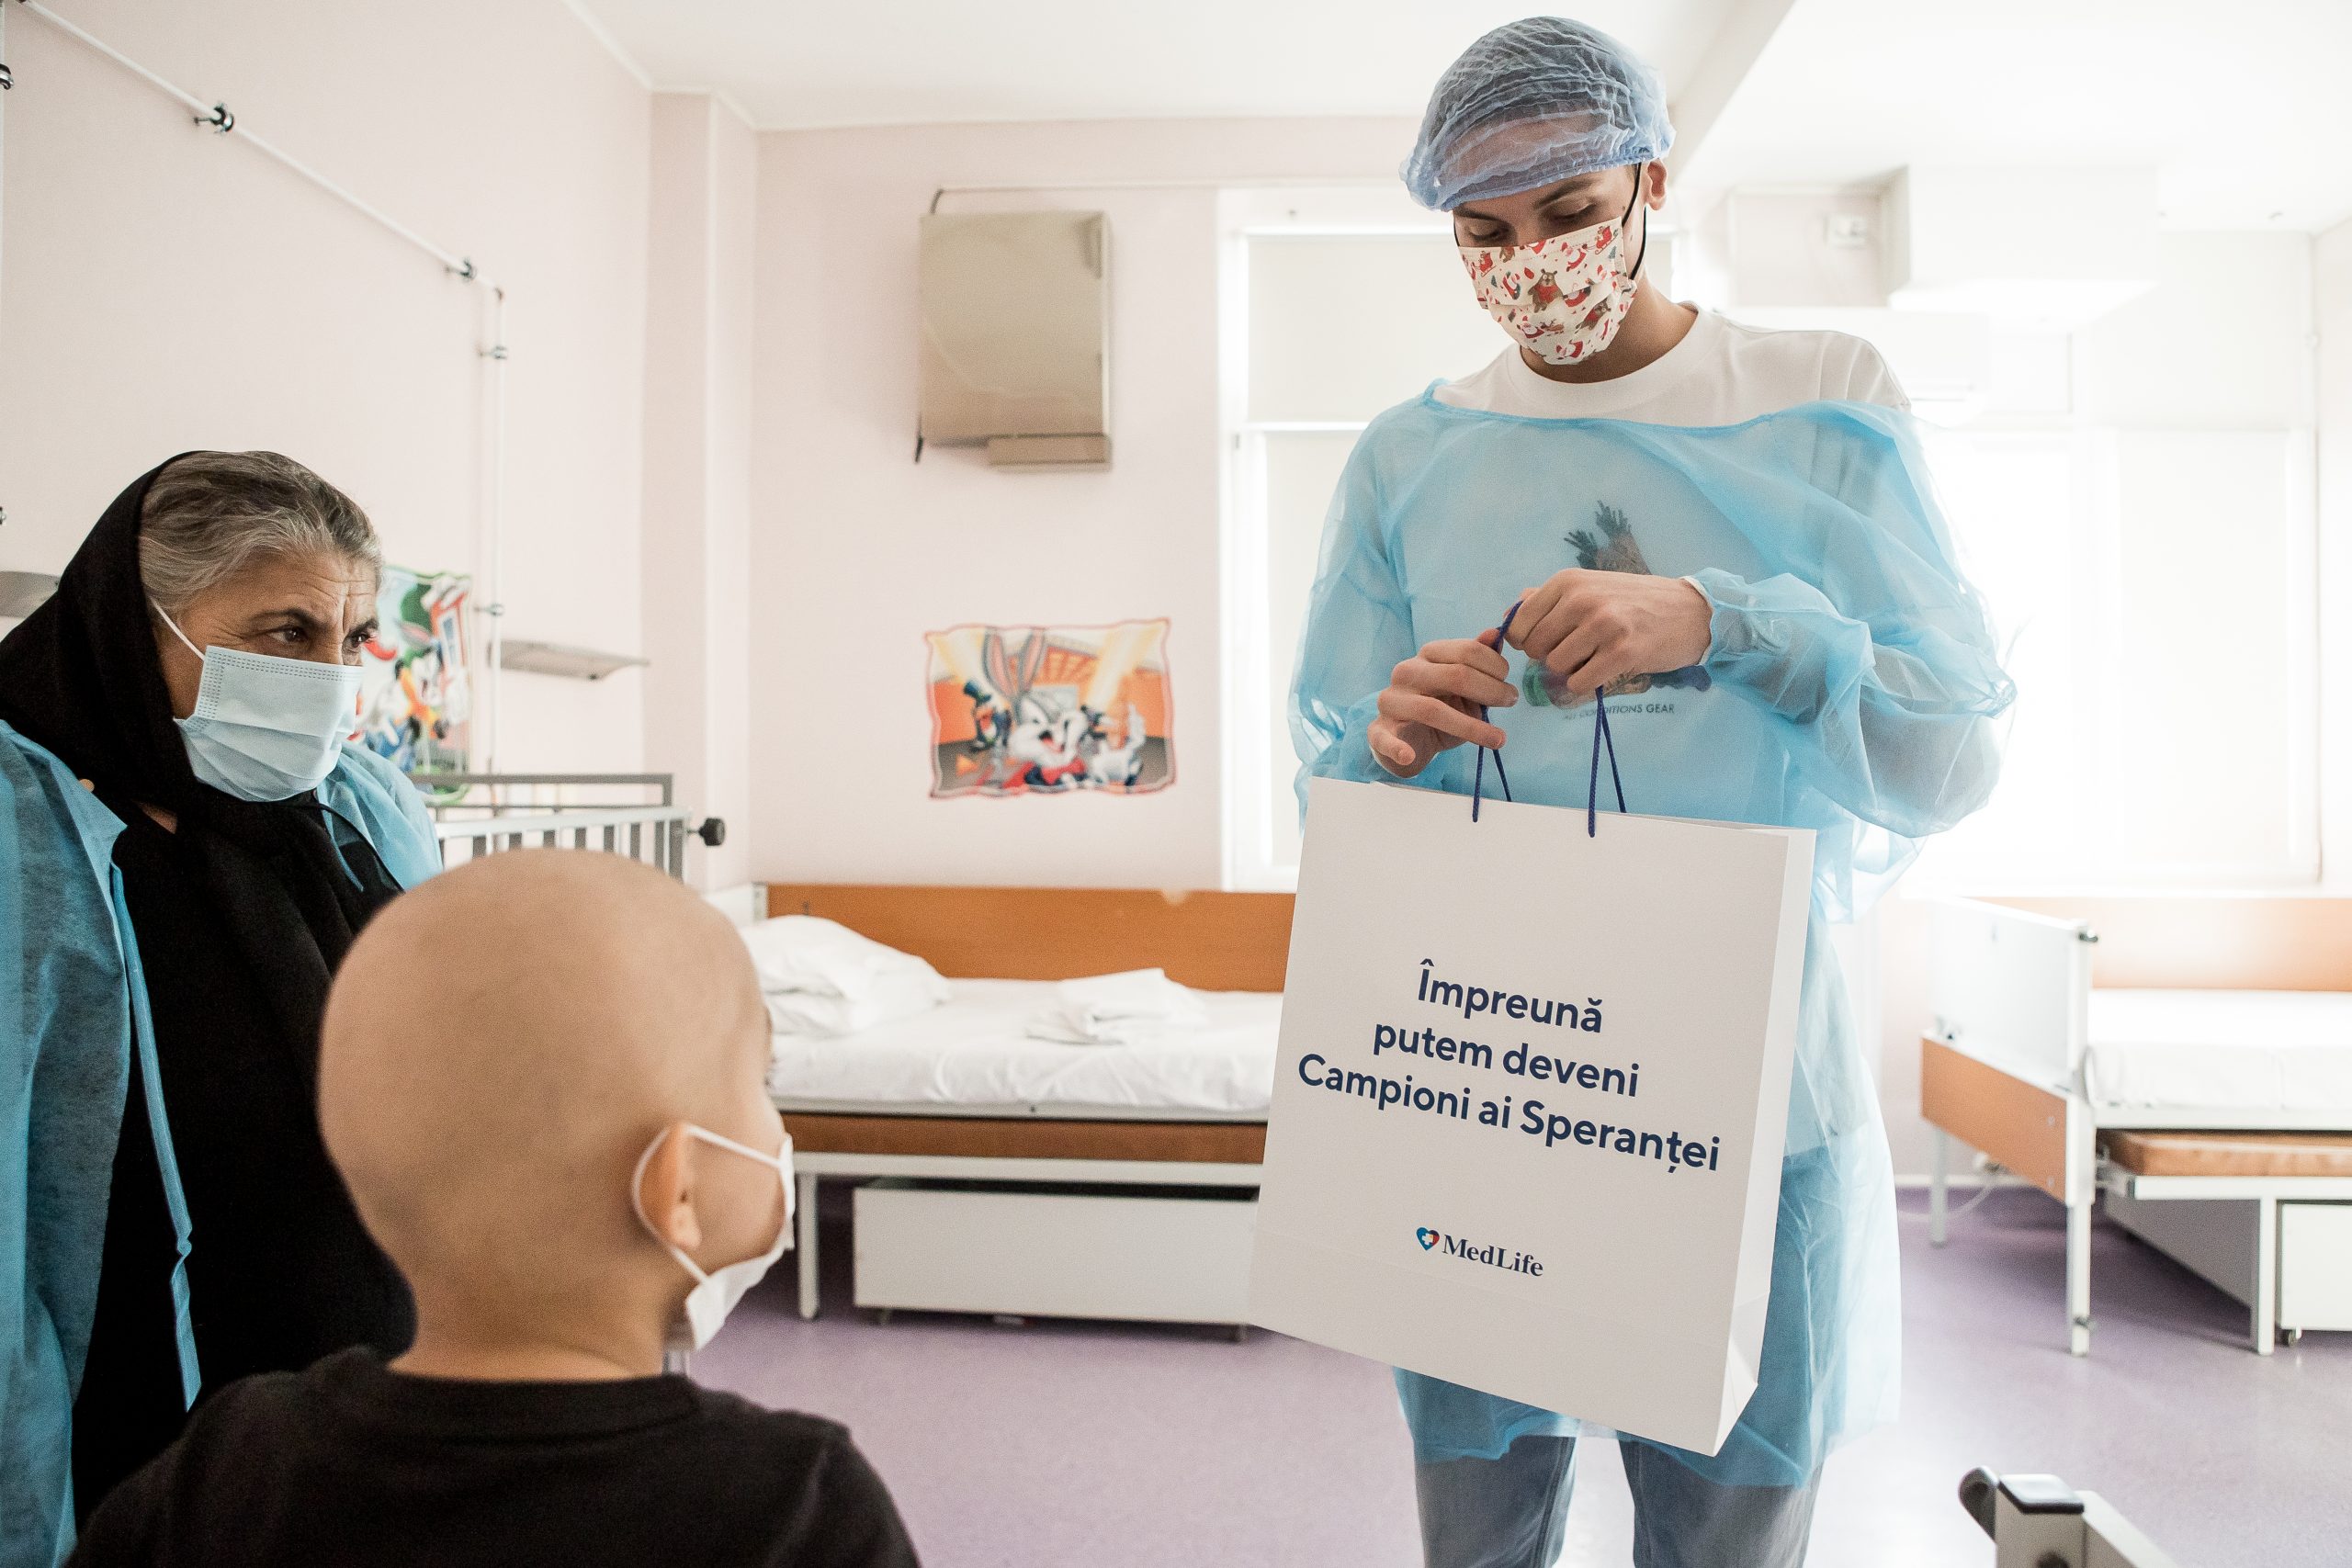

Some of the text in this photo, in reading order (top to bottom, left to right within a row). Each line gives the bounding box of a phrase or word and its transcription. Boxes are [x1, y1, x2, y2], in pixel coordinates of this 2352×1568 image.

[1645, 703, 1675, 714] GEAR
[1418, 958, 1603, 1033] Împreună
[1373, 1023, 1640, 1098] putem deveni
[1298, 1053, 1720, 1174] Campioni ai Speranței
[1442, 1234, 1544, 1277] MedLife
